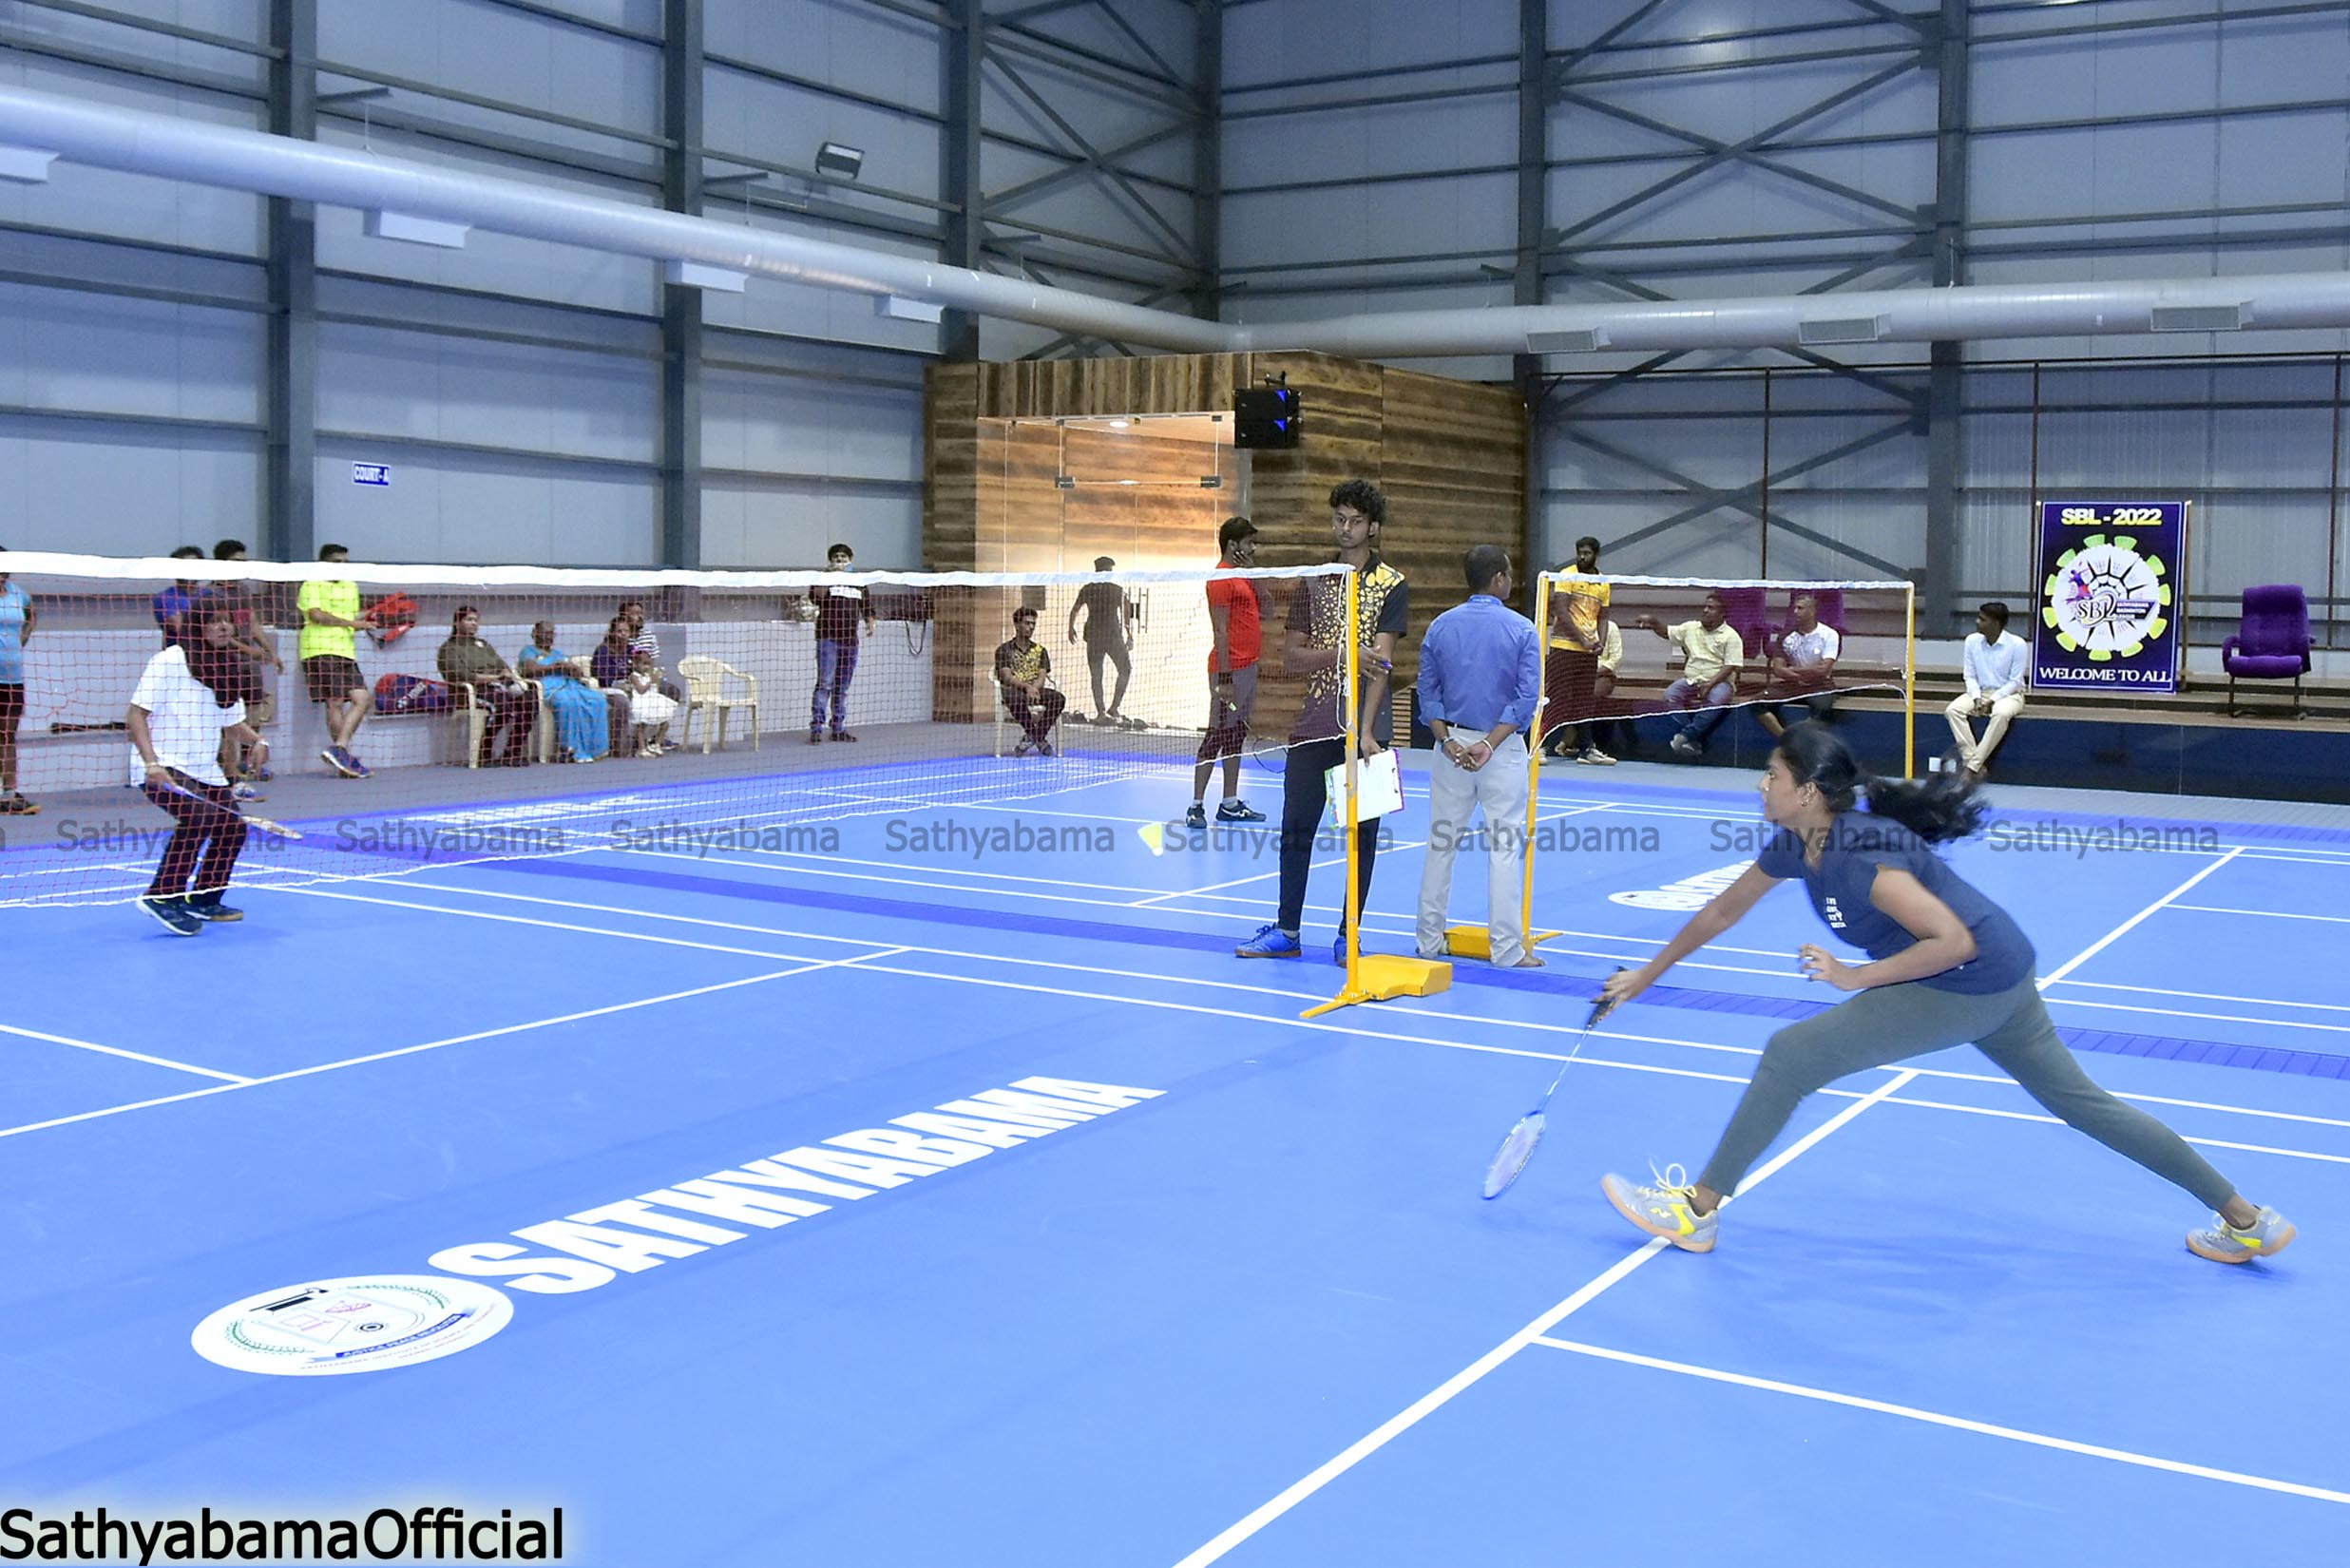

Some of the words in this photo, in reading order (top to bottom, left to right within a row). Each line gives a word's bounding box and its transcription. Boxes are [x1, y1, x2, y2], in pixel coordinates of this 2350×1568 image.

[2060, 507, 2102, 526] SBL
[2112, 507, 2163, 526] 2022
[2039, 667, 2116, 681] WELCOME
[2118, 669, 2140, 681] TO
[2142, 670, 2171, 682] ALL
[428, 1076, 1168, 1294] SATHYABAMA
